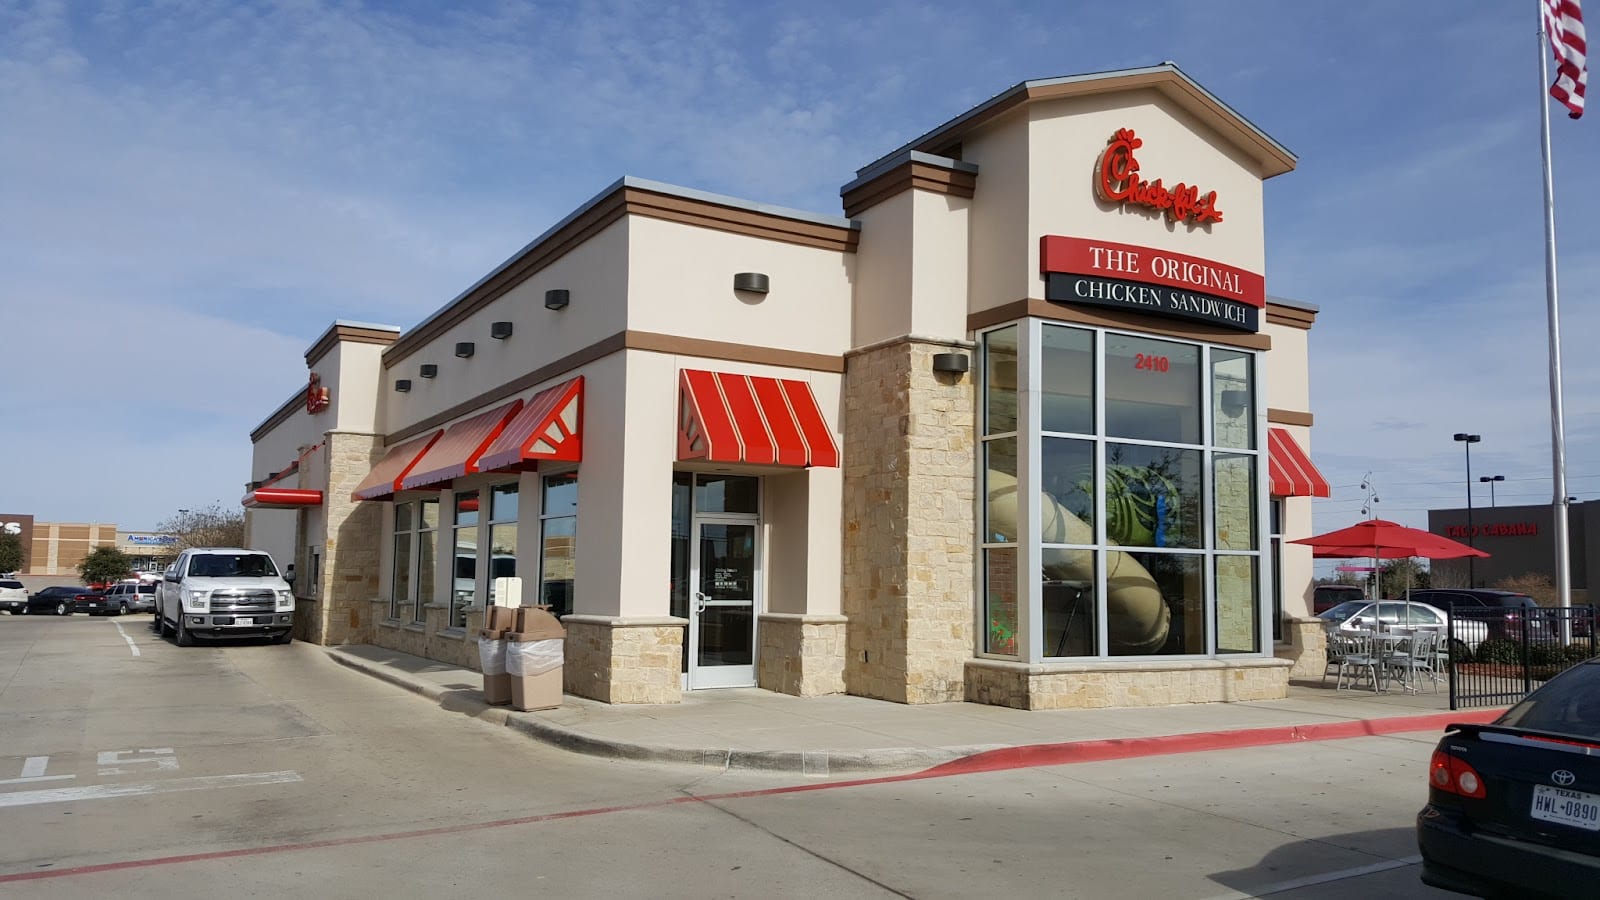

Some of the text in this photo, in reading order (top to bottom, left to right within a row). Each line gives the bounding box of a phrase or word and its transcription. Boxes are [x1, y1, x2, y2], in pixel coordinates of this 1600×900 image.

[1101, 127, 1223, 222] Chick-fil-A
[1089, 247, 1243, 295] THE ORIGINAL
[1074, 279, 1246, 324] CHICKEN SANDWICH
[1135, 353, 1169, 372] 2410
[1446, 522, 1537, 537] TACO CABANA
[1556, 789, 1582, 800] TEXAS
